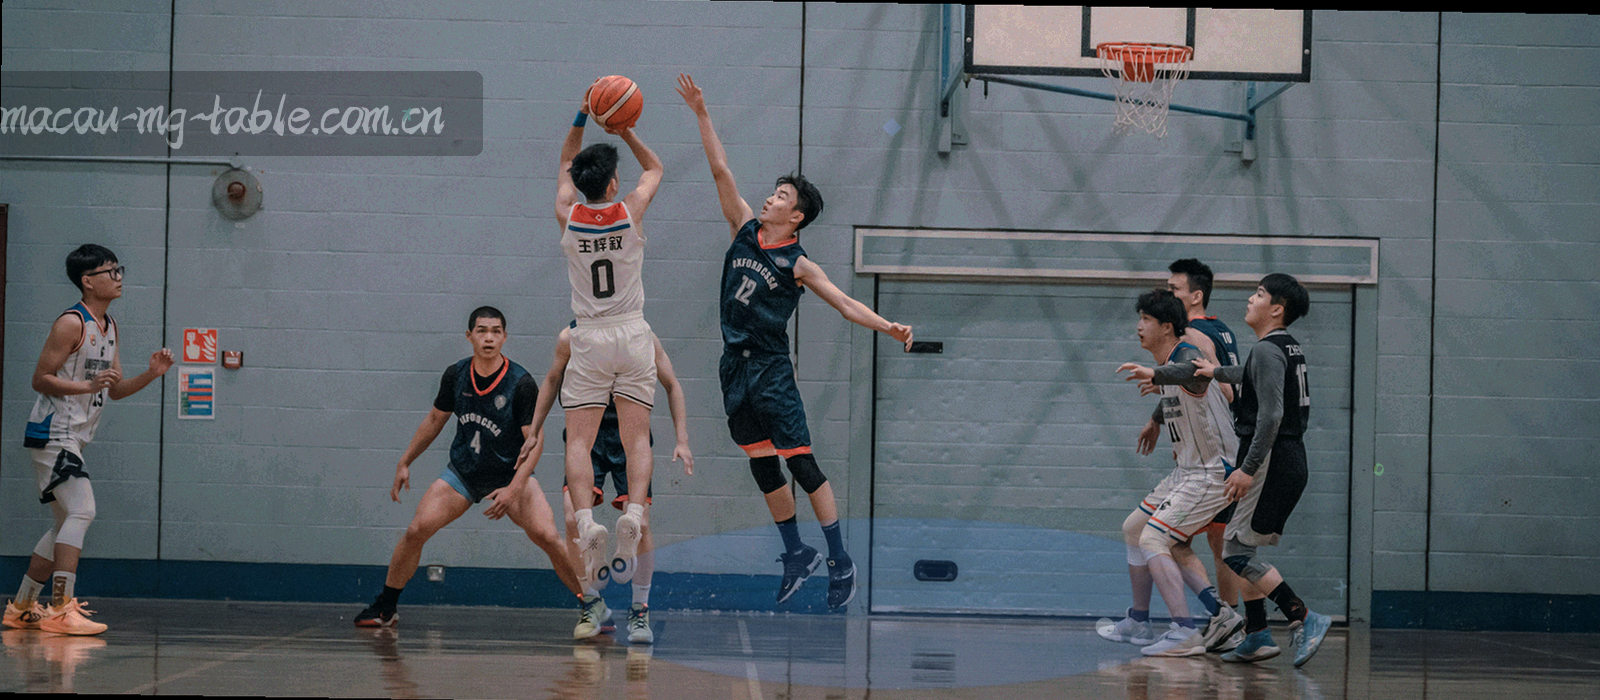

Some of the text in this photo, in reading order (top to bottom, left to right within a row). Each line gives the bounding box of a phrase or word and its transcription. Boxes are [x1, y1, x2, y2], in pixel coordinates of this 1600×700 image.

[590, 258, 616, 300] 0
[734, 274, 757, 306] 12
[469, 430, 481, 455] 4
